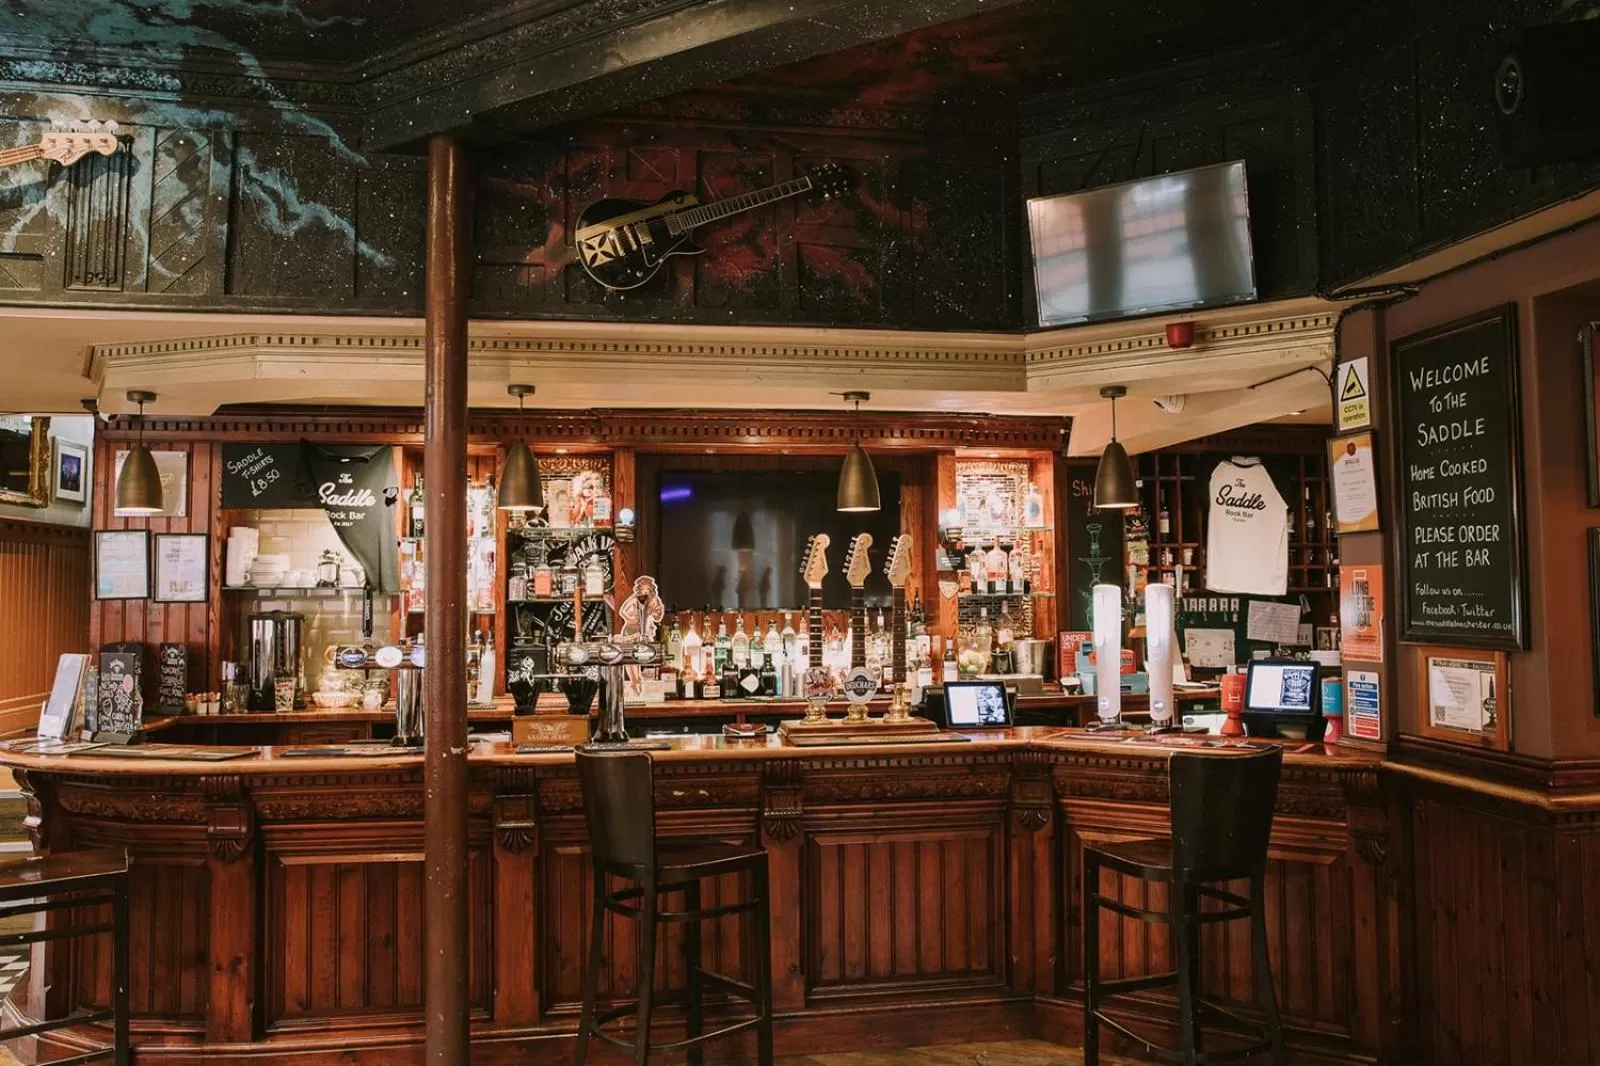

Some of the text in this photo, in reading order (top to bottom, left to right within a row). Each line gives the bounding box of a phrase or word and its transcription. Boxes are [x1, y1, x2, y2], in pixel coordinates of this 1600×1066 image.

[1409, 356, 1490, 392] WELCOME
[1343, 405, 1358, 414] CCTV
[1443, 391, 1468, 410] THE
[1417, 418, 1485, 447] SADDLE
[227, 447, 264, 475] SADDLE
[1410, 458, 1488, 482] HOME COOKED
[318, 482, 377, 507] Saddle
[1072, 479, 1093, 497] Shi
[1215, 484, 1267, 511] Saddle
[1412, 485, 1496, 512] BRITISH FOOD
[349, 511, 366, 520] Bar
[1225, 508, 1241, 517] Rock
[1415, 524, 1500, 544] PLEASE ORDER
[1414, 548, 1491, 569] AT THE BAR
[1415, 582, 1440, 596] Follow
[1422, 601, 1496, 617] Facebook Twitter
[1063, 634, 1087, 643] UNDER
